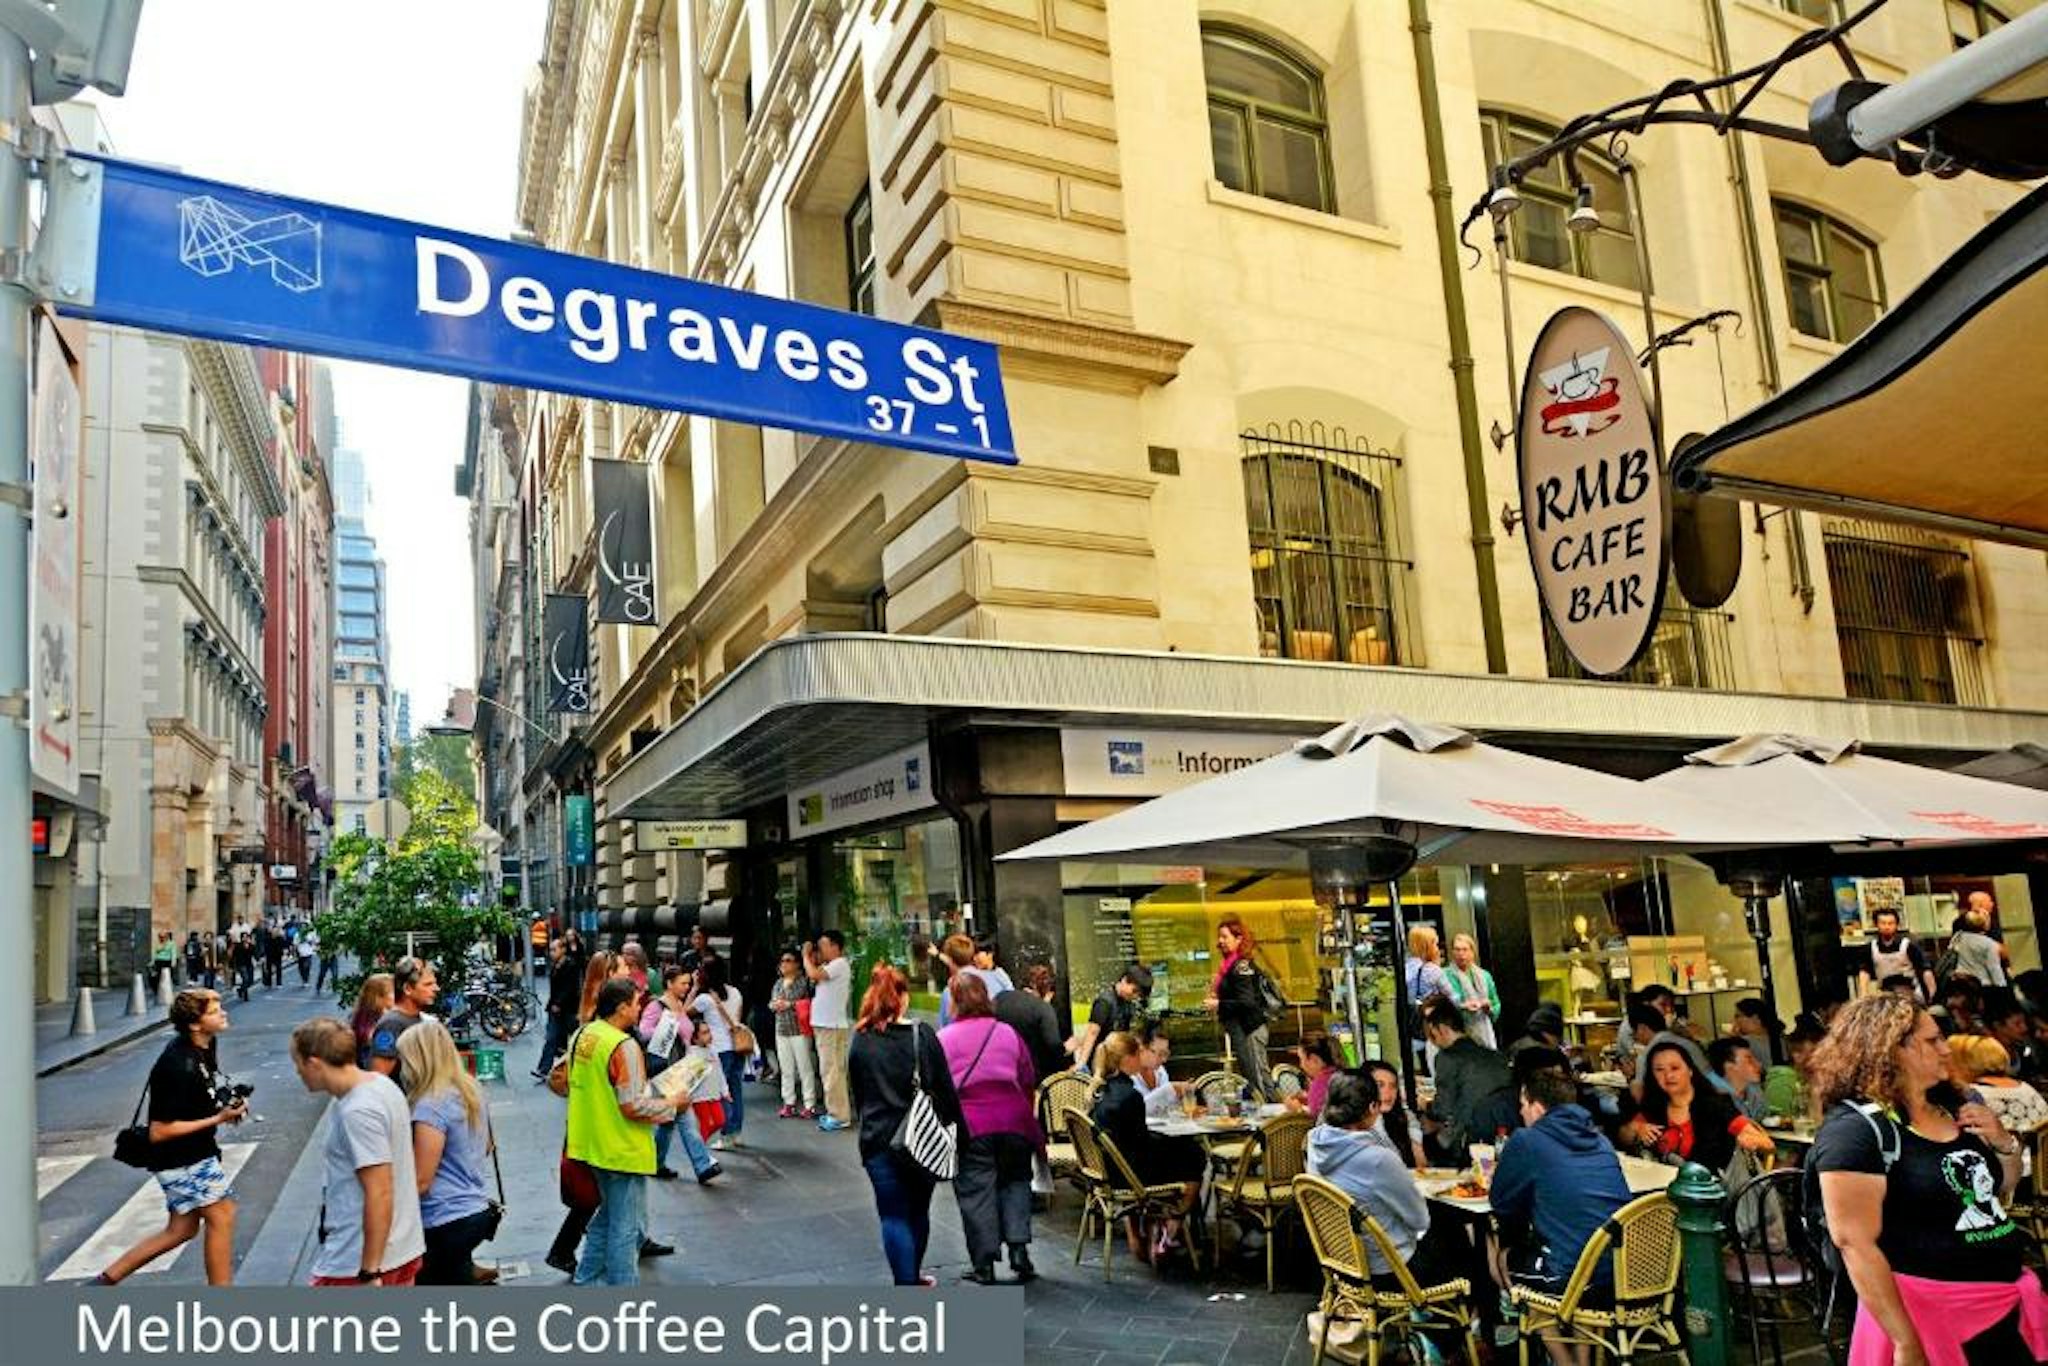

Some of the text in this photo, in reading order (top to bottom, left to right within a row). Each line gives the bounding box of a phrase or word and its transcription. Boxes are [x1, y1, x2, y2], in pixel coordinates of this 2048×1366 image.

[415, 235, 985, 413] Degraves St
[866, 396, 915, 434] 37
[974, 414, 991, 448] 1
[1537, 449, 1649, 531] RMB
[1552, 518, 1645, 572] CAFE
[623, 561, 652, 621] CAE
[1568, 574, 1644, 622] BAR
[568, 668, 588, 711] CAE
